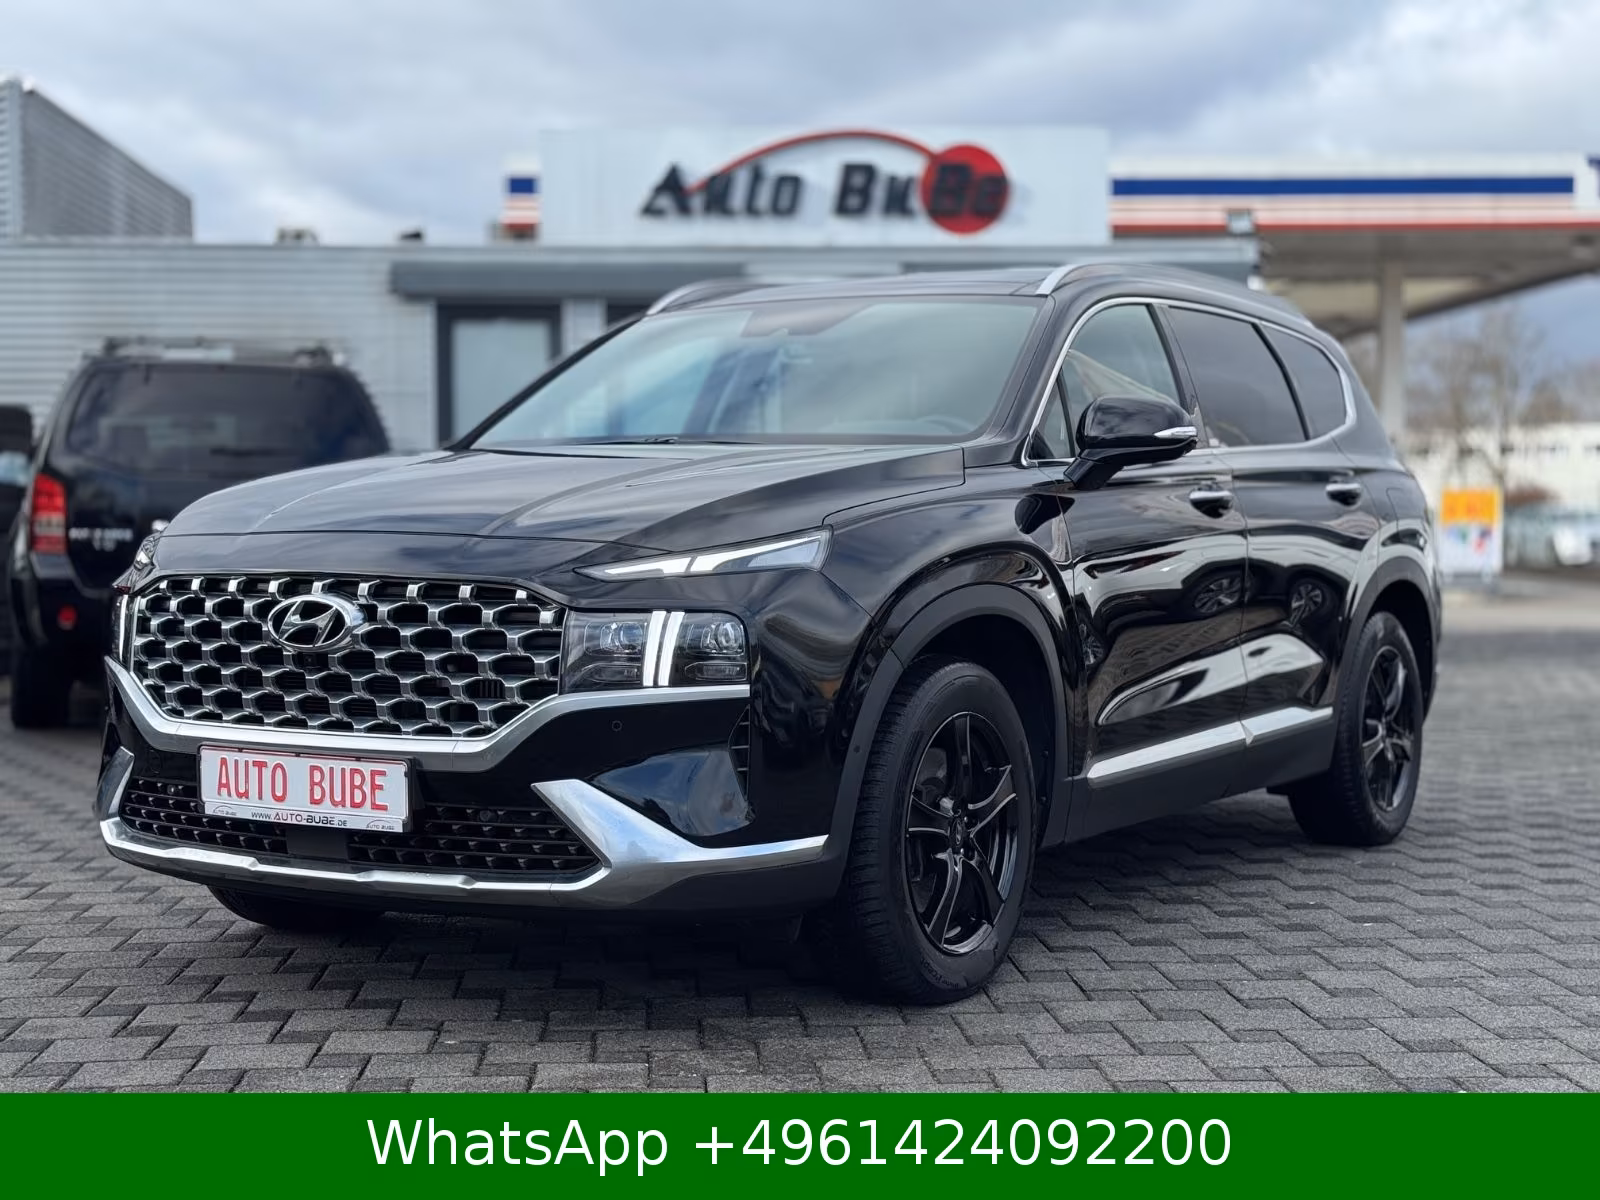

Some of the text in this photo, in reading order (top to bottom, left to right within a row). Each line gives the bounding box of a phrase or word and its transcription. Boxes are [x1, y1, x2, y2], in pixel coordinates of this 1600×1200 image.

[639, 161, 803, 219] Auto
[216, 756, 389, 812] AUTO BUBE
